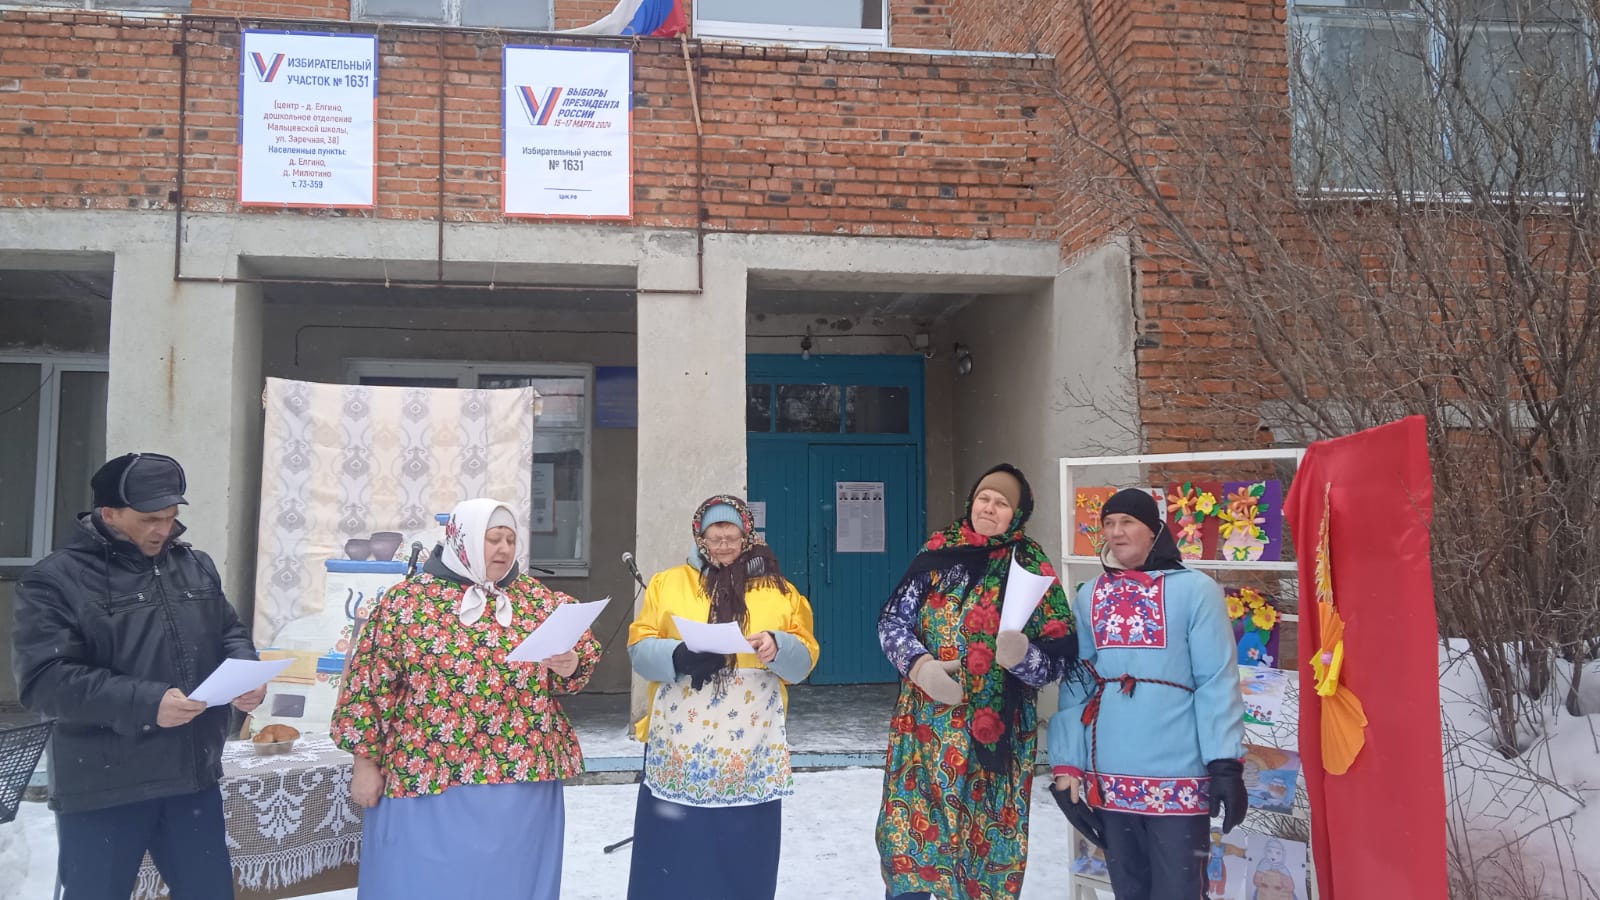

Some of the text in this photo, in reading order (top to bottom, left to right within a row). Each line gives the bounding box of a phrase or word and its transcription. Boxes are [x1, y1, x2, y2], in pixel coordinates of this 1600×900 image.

[287, 57, 372, 71] ИЗБИРАТЕЛЬНЫЙ
[287, 74, 369, 88] УЧАСТОК № 1631
[566, 87, 608, 98] ВЫБОРЫ
[315, 103, 343, 112] Елгино,
[562, 98, 620, 109] ПРЕЗИДЕНТА
[263, 112, 353, 123] дошкольное отделение
[557, 109, 595, 119] РОССИИ
[267, 122, 349, 135] Мальцевской школы,
[573, 120, 595, 129] МАРТА
[288, 135, 326, 144] Заречная,
[268, 145, 347, 157] Населенные пункты:
[522, 146, 613, 158] Избирательный участок
[298, 158, 326, 167] Елгино,
[548, 159, 584, 171] № 1631
[292, 168, 332, 178] Милютино
[298, 179, 324, 189] 73-359
